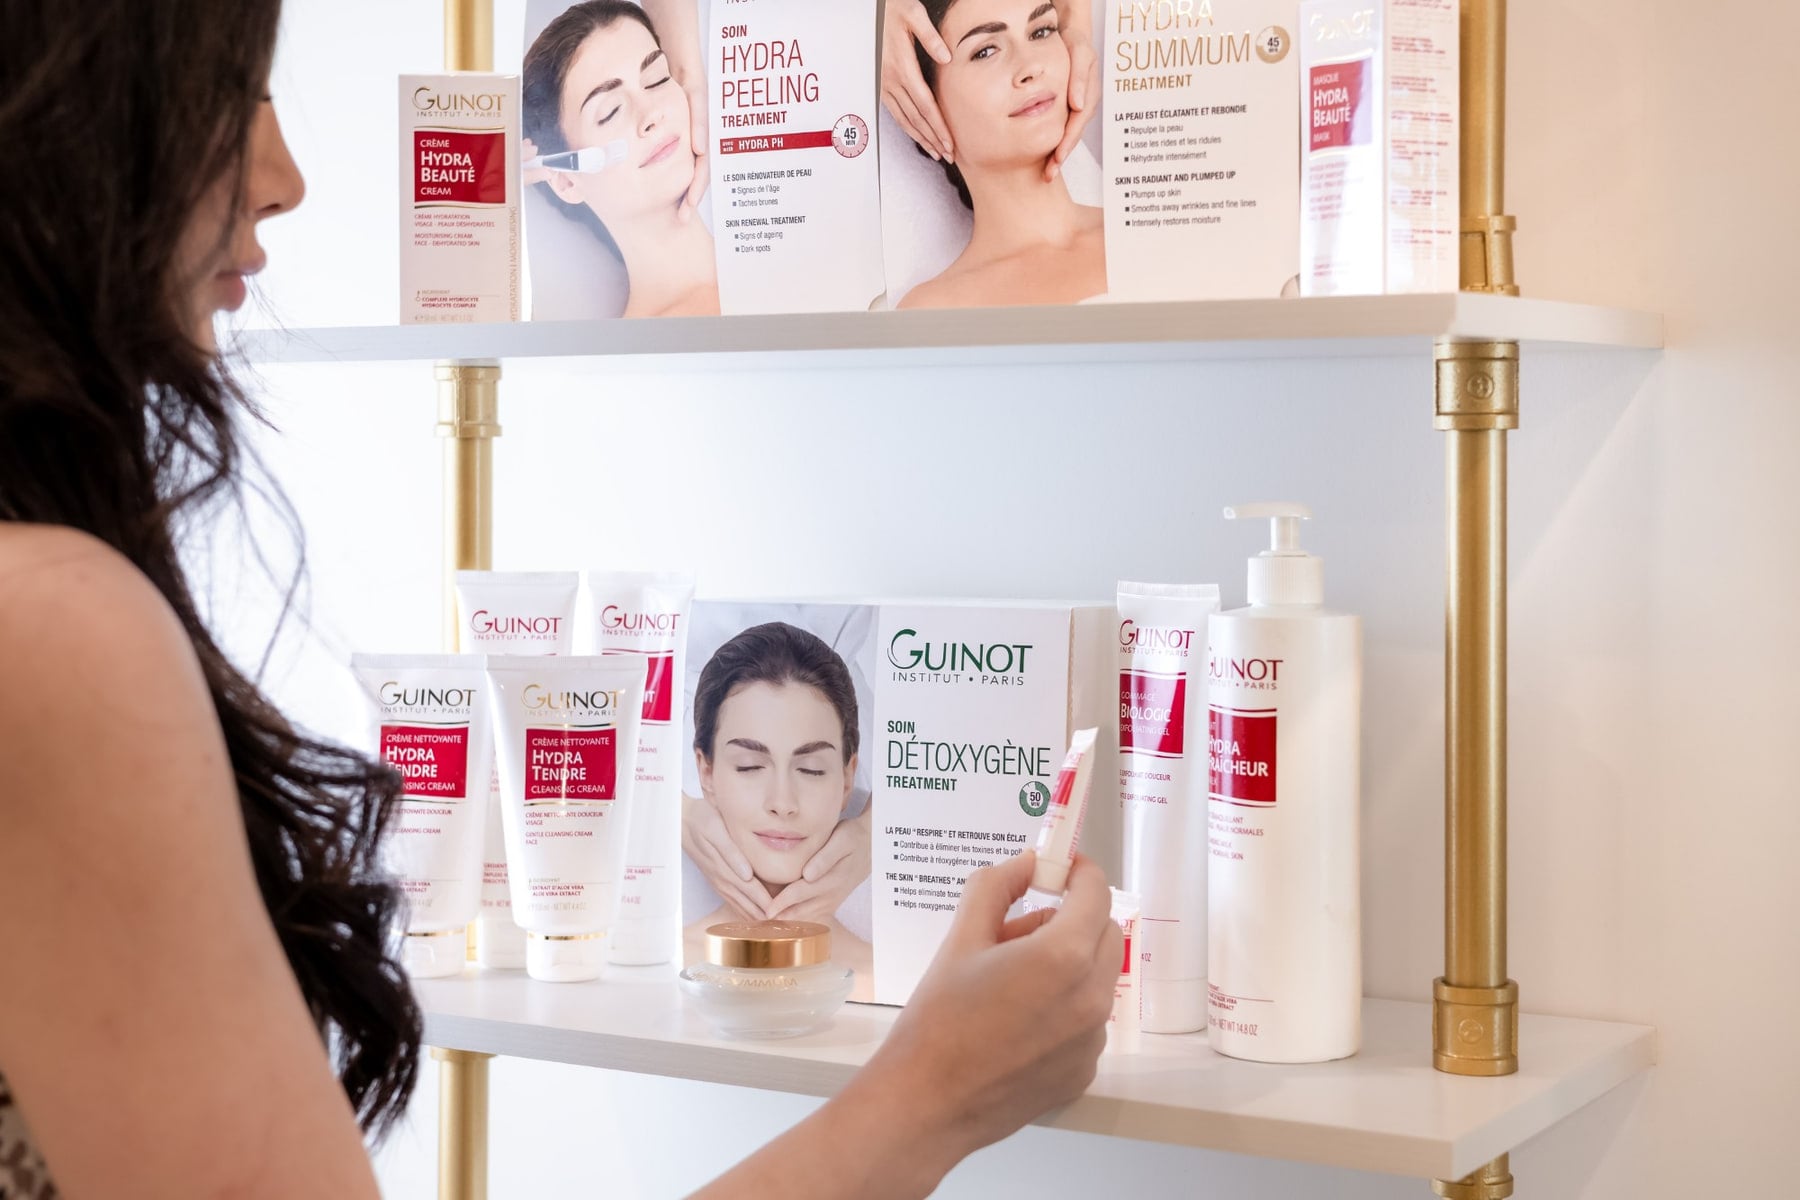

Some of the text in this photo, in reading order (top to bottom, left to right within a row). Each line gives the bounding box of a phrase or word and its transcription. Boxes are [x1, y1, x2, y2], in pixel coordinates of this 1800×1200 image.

[1117, 0, 1214, 33] HYDRA
[722, 25, 747, 38] SOIN
[1267, 37, 1279, 47] 45
[722, 39, 803, 73] HYDRA
[1116, 30, 1250, 72] SUMMUM
[1115, 74, 1192, 92] TREATMENT
[722, 73, 819, 109] PEELING
[1313, 87, 1348, 107] HYDRA
[413, 87, 506, 111] GUINOT
[722, 111, 787, 128] TREATMENT
[1115, 105, 1246, 121] LA PEAU EST ÉCLATANTE ET REBONDIE
[1313, 103, 1351, 128] BEAUTÉ
[844, 128, 856, 139] 45
[1131, 126, 1157, 135] Repulpe
[1166, 125, 1183, 133] peau
[420, 139, 450, 148] CRÈME
[739, 139, 768, 150] HYDRA
[772, 138, 783, 148] PH
[1131, 140, 1148, 149] Lisse
[1150, 140, 1159, 148] les
[1161, 139, 1177, 147] rides
[1179, 138, 1185, 146] et
[1199, 136, 1221, 145] ridules
[421, 150, 472, 166] HYDRA
[1131, 154, 1164, 164] Réhydrate
[421, 167, 475, 183] BEAUTÉ
[723, 174, 730, 182] LE
[732, 173, 746, 181] SOIN
[747, 170, 785, 180] RÉNOVATEUR
[796, 169, 811, 177] PEAU
[1115, 171, 1236, 185] SKIN IS RADIANT AND PLUMPED UP
[421, 187, 452, 195] CREAM
[737, 186, 756, 194] Signes
[1131, 190, 1155, 200] Plumps
[1157, 191, 1166, 199] up
[738, 198, 778, 207] Taches brunes
[1131, 199, 1256, 213] Smooths away wrinkles and fine lines
[741, 218, 769, 226] RENEWAL
[771, 216, 806, 224] TREATMENT
[1132, 215, 1221, 228] Intensely restores moisture
[740, 231, 783, 240] Signs of ageing
[741, 245, 770, 253] Dark spots
[471, 610, 563, 633] GUINOT
[601, 605, 680, 630] GUINOT
[1120, 619, 1195, 649] GUINOT
[887, 629, 1033, 673] GUINOT
[893, 672, 1024, 686] INSTITUT PARIS
[1244, 682, 1277, 690] PARIS
[379, 682, 476, 706] GUINOT
[521, 684, 622, 709] GUINOT
[1121, 703, 1171, 722] BIOLOGIC
[887, 720, 915, 734] SOIN
[386, 733, 461, 744] CRÈME NETTOYANTE
[532, 737, 609, 746] CRÈME NETTOYANTE
[386, 746, 435, 761] HYDRA
[533, 749, 583, 764] HYDRA
[888, 735, 1050, 777] DÉTOXYGÈNE
[1210, 753, 1268, 777] RAÎCHEUR
[532, 766, 586, 781] TENDRE
[403, 782, 455, 790] NSING CREAM
[531, 785, 606, 794] CLEANSNG CREAM
[887, 775, 957, 791] TREATMENT
[1030, 792, 1041, 802] 50
[885, 826, 894, 835] LA
[895, 827, 911, 835] PEAU
[948, 830, 956, 838] ET
[958, 831, 990, 840] RETROUVE
[992, 833, 1005, 841] SON
[1007, 833, 1026, 842] ÉCLAT
[900, 840, 928, 850] Contribue
[930, 842, 934, 850] à
[935, 842, 960, 851] éliminer
[962, 844, 970, 852] les
[972, 846, 994, 854] toxines
[1003, 847, 1009, 855] la
[900, 854, 929, 863] Contribue
[930, 855, 935, 863] à
[970, 858, 976, 866] la
[886, 872, 897, 880] THE
[899, 873, 913, 882] SKIN
[957, 877, 967, 885] AN
[900, 887, 946, 898] Helps eliminate
[900, 900, 955, 911] Helps reoxygenate
[1236, 1023, 1248, 1033] 14.8
[1249, 1024, 1257, 1036] OZ
